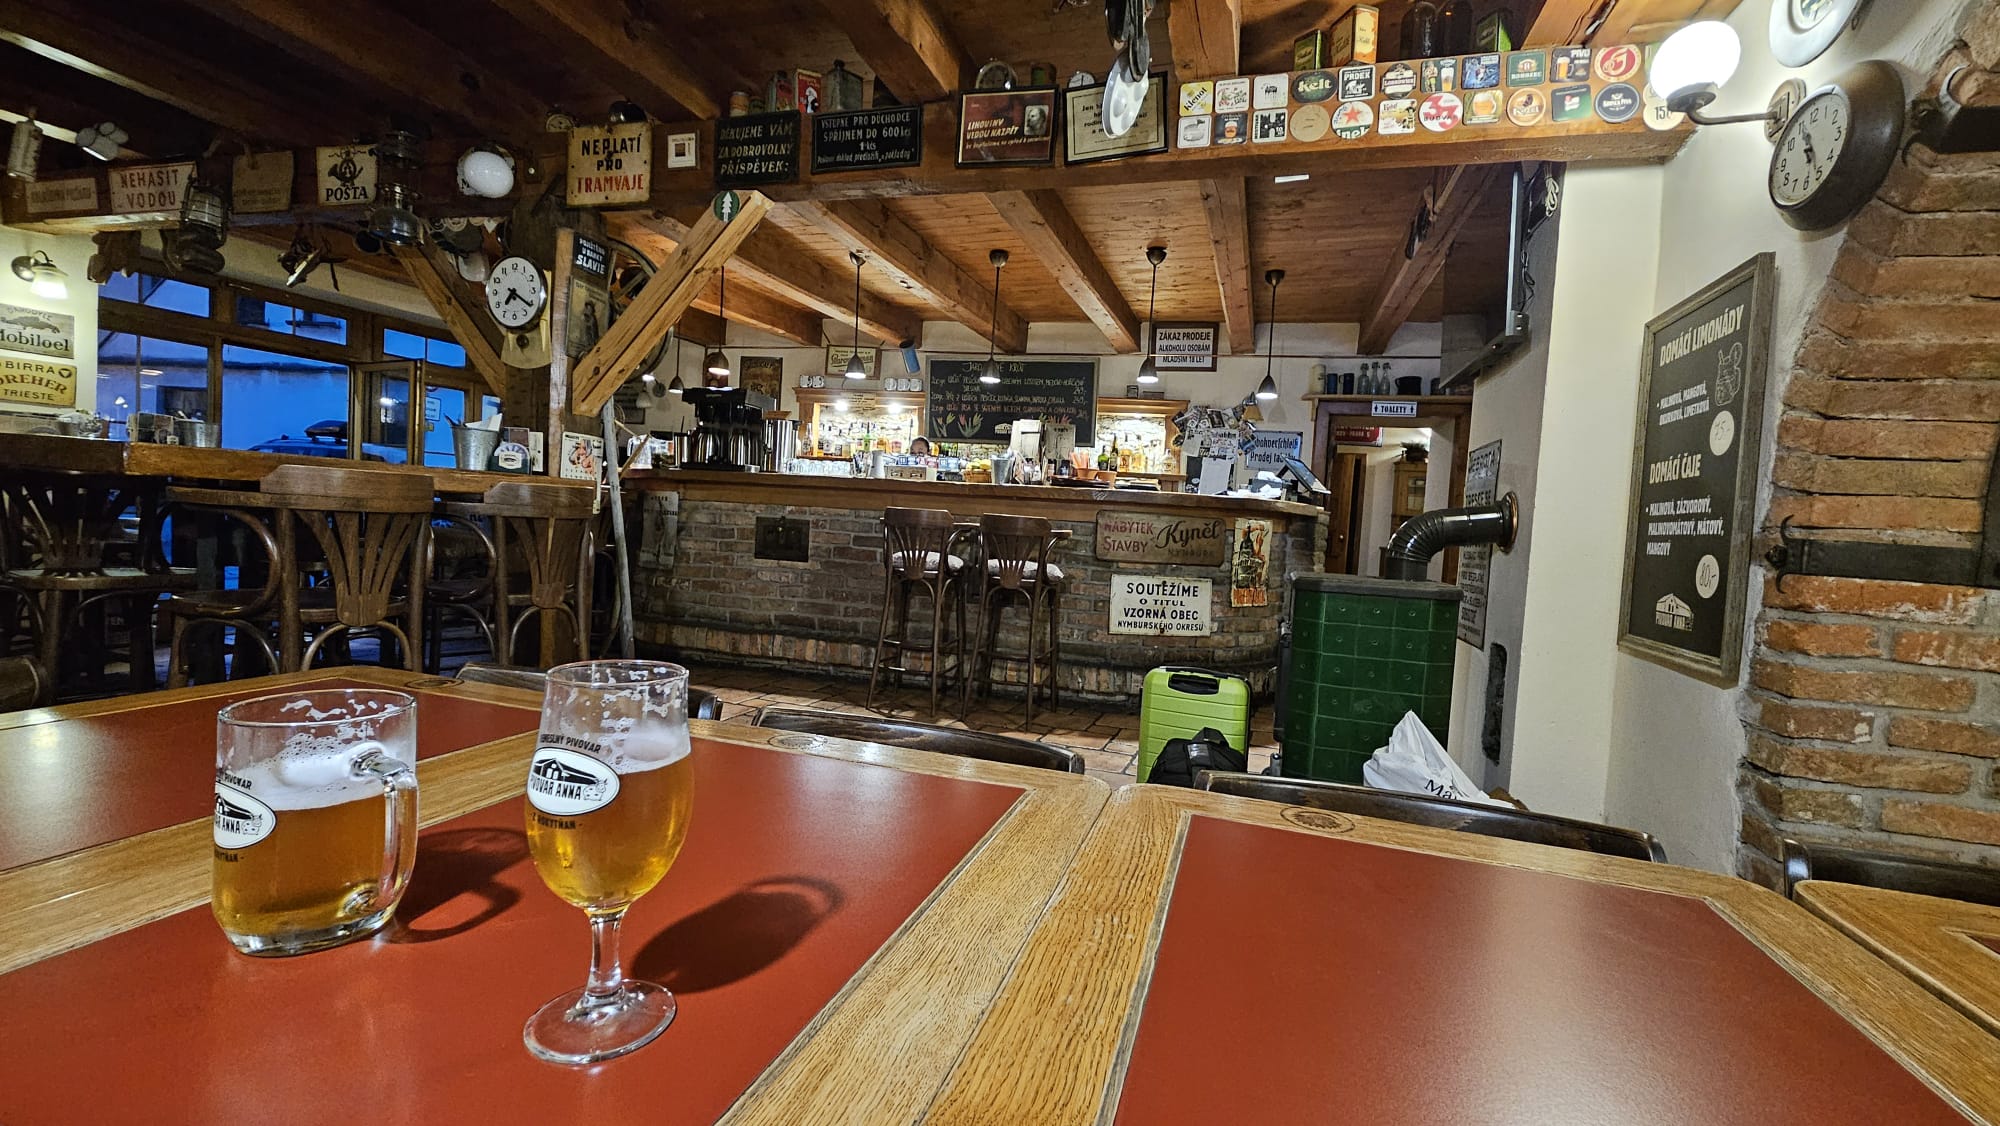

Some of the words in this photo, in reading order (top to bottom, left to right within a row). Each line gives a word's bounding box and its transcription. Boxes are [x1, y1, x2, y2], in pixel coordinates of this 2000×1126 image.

[854, 116, 869, 126] PRO
[1810, 108, 1819, 124] 12
[1832, 109, 1838, 125] 2
[866, 128, 878, 139] DO
[1834, 126, 1842, 142] 3
[582, 133, 642, 156] NEPLATÍ
[1788, 137, 1796, 152] 10
[1826, 148, 1834, 162] 4
[596, 158, 622, 172] PRO
[1780, 158, 1787, 172] 9
[120, 169, 180, 188] NEHASIT
[1783, 172, 1790, 187] 8
[1816, 166, 1822, 181] 5
[577, 174, 644, 194] TRAMVAJE
[1792, 178, 1798, 192] 7
[1802, 176, 1810, 191] 6
[126, 191, 176, 208] VODOU
[325, 184, 368, 202] POŠTA
[575, 255, 606, 275] SLAVIE
[1158, 331, 1181, 341] ZÁKAZ
[1182, 332, 1212, 342] PRODEJE
[1660, 327, 1692, 367] DOMÁCÍ
[1692, 304, 1745, 351] LIMONÁDY
[1158, 344, 1187, 352] ALKOHOLU
[1187, 343, 1211, 352] OSOBÁM
[5, 360, 55, 374] BIRRA
[1189, 356, 1196, 364] 18
[1196, 356, 1205, 364] LET
[4, 388, 55, 401] TRIESTE
[1250, 450, 1272, 465] Prodej
[1648, 455, 1682, 484] DOMÁCÍ
[1682, 452, 1702, 478] ČAJE
[1103, 517, 1154, 536] NÁBYTEK
[1154, 520, 1221, 549] Kynčl
[1102, 536, 1148, 553] STAVBY
[1126, 581, 1199, 598] SOUTĚŽÍME
[1138, 598, 1148, 606] O
[1152, 598, 1186, 608] TITUL
[1123, 606, 1166, 620] VZORNÁ
[1170, 609, 1199, 620] OBEC
[1117, 620, 1174, 632] NYMBURSKÉHO
[1176, 622, 1204, 632] OKRESU
[566, 736, 602, 754] PIVOVAR
[555, 782, 582, 800] ANNA
[1424, 779, 1456, 800] Ma
[222, 818, 240, 834] ANNA
